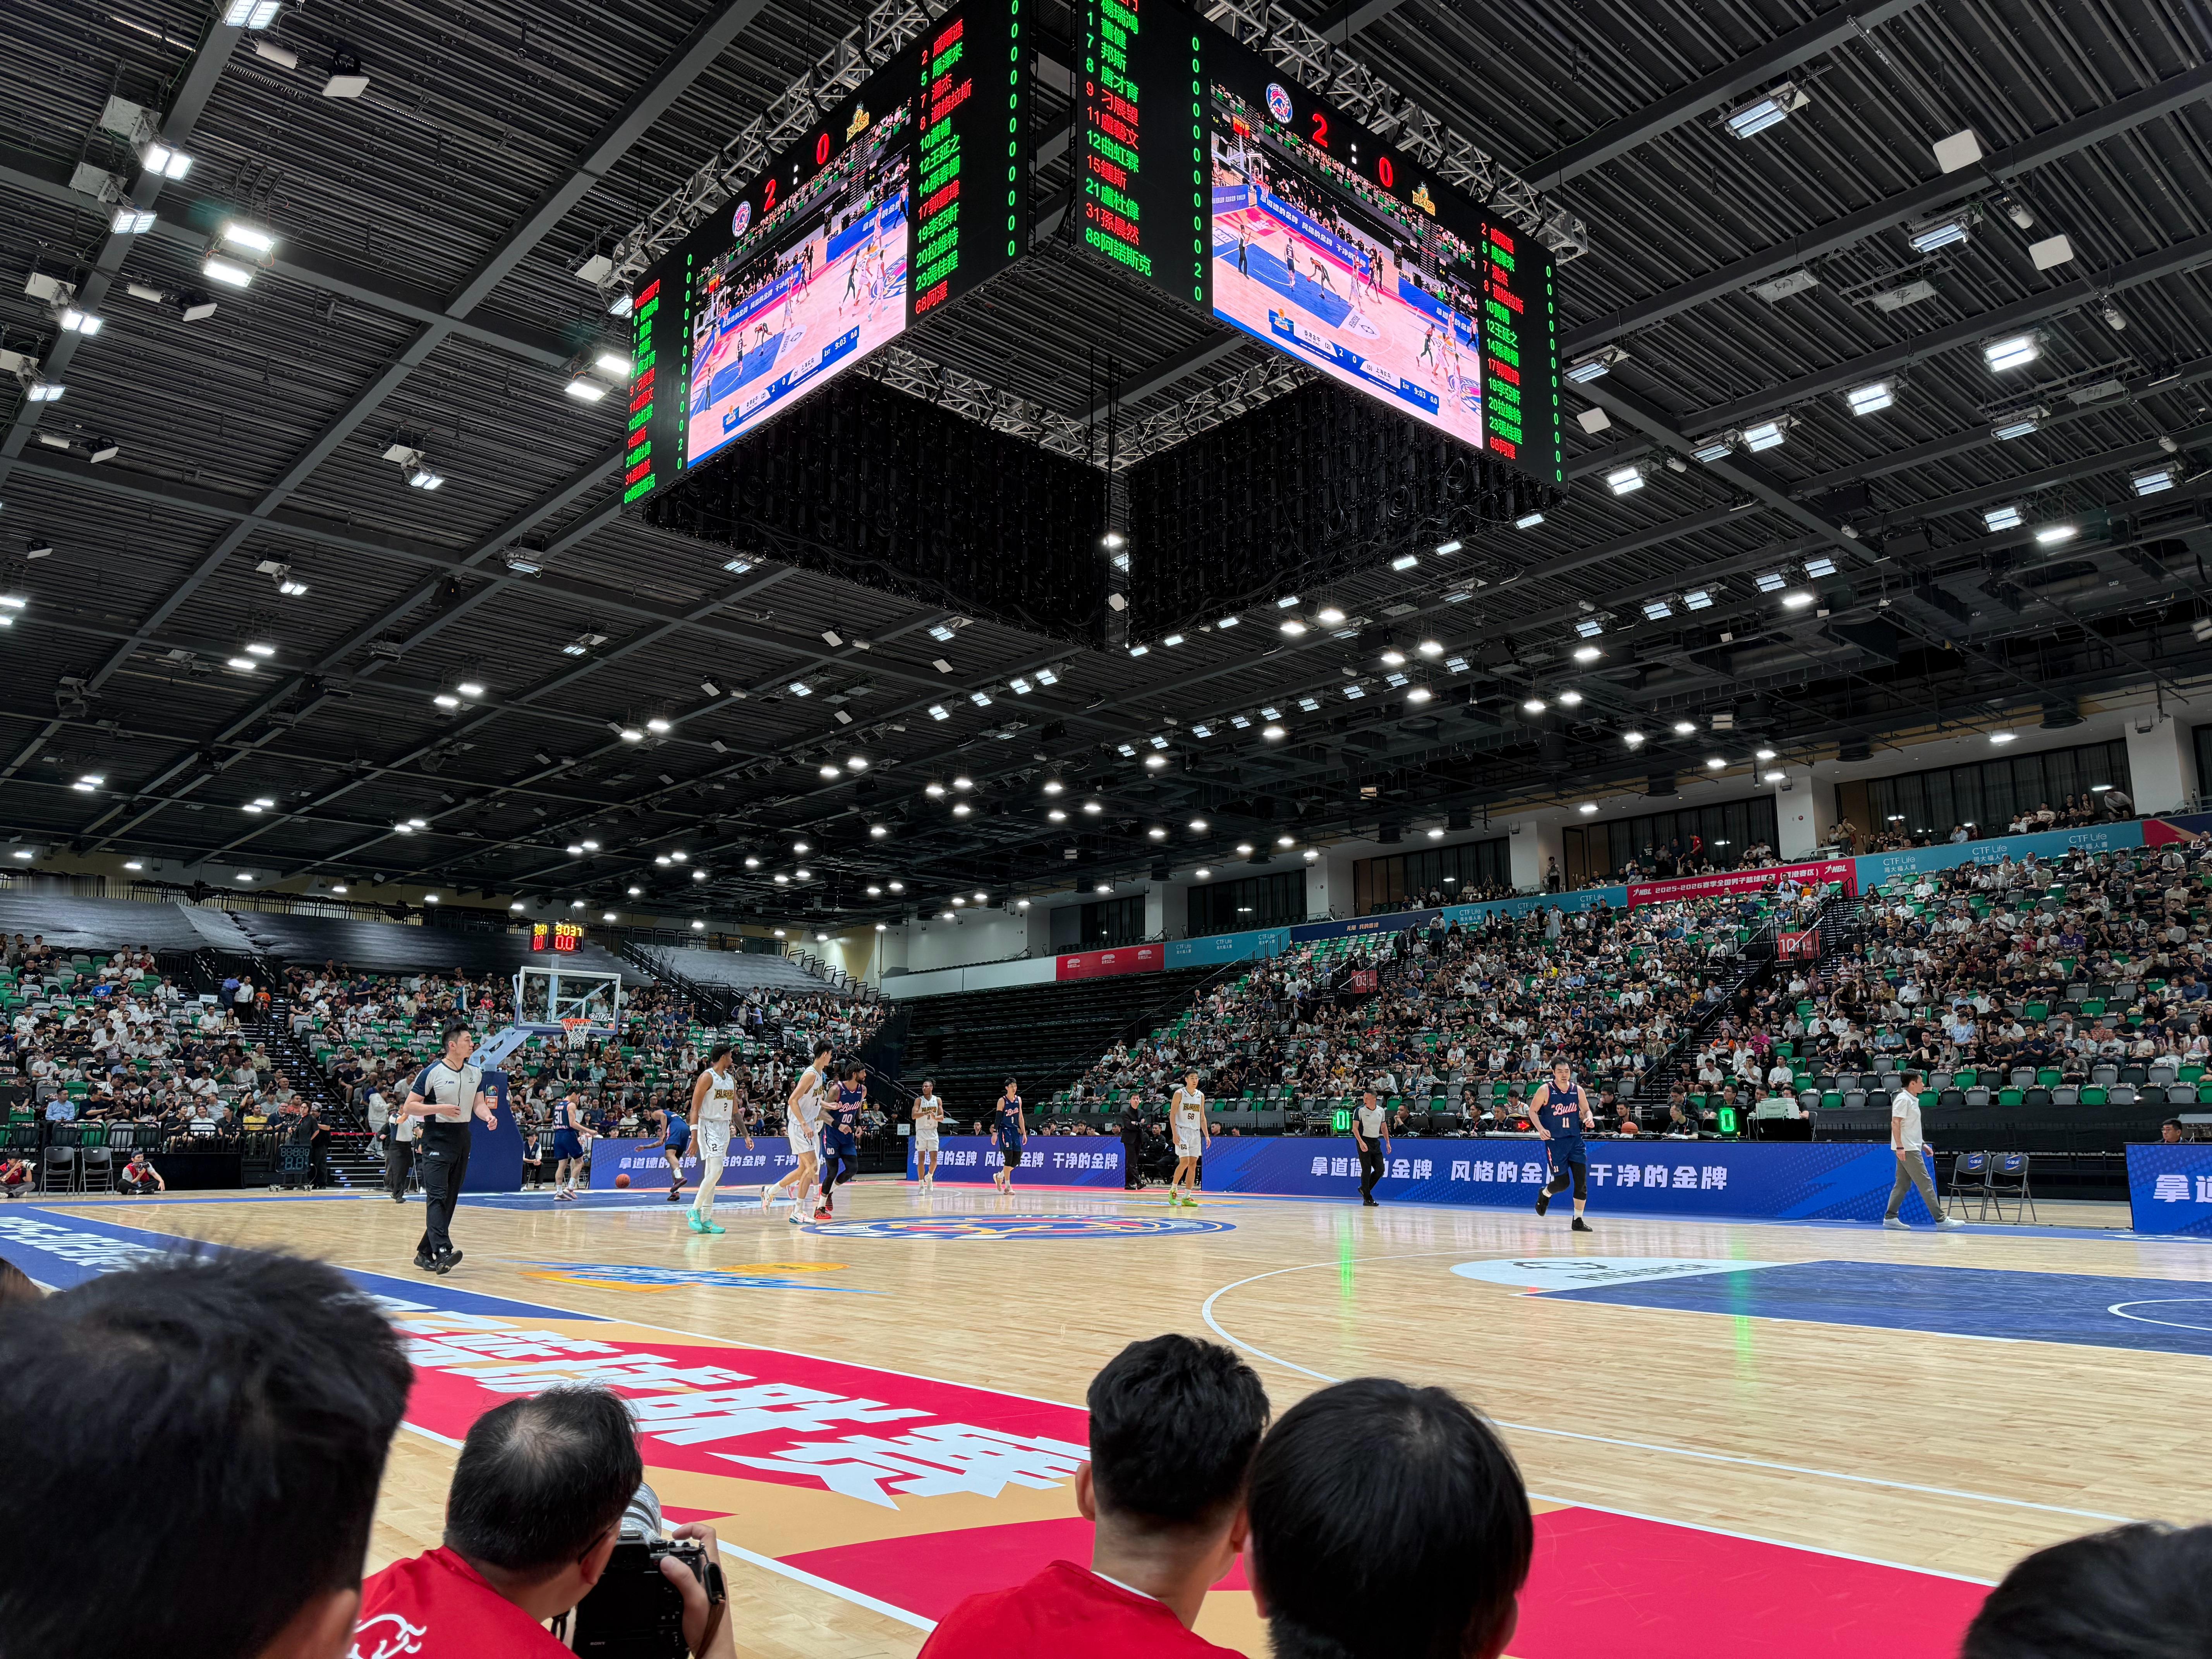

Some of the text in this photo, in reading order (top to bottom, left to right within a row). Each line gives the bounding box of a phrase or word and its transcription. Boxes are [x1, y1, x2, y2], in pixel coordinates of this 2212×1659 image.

[1012, 23, 1018, 38] 0
[921, 0, 1018, 86] 5 馬澤來 0
[1192, 37, 1199, 51] 0
[922, 50, 928, 65] 2
[1087, 12, 1199, 95] 1 董健 0
[1193, 59, 1199, 73] 0
[1010, 70, 1017, 85] 0
[1087, 33, 1200, 117] 7 邦斯 0
[920, 46, 1018, 130] 8 道格拉斯 0
[1010, 94, 1017, 109] 0
[1087, 58, 1200, 139] 8 唐才育 0
[1010, 118, 1016, 132] 0
[1086, 81, 1200, 162] 9 刁展望 0
[1009, 141, 1016, 157] 0
[1312, 113, 1393, 187] 2 0
[764, 133, 829, 212] 2 0
[1009, 166, 1015, 181] 0
[1194, 170, 1200, 184] 0
[1008, 191, 1015, 206] 0
[1194, 193, 1200, 207] 0
[1008, 215, 1015, 230] 0
[1194, 216, 1201, 230] 0
[1481, 223, 1486, 235] 2
[1008, 240, 1015, 256] 0
[1194, 239, 1201, 254] 0
[1482, 241, 1487, 254] 5
[1195, 263, 1201, 278] 2
[1483, 260, 1487, 271] 7
[1195, 286, 1201, 301] 0
[1484, 280, 1523, 314] 8 道格拉斯
[634, 315, 638, 326] 0
[633, 333, 636, 343] 1
[835, 337, 846, 350] 9:03
[630, 350, 656, 379] 8 唐才育
[630, 385, 634, 397] 9
[1414, 387, 1426, 399] 9:03
[2069, 833, 2107, 843] CTF Life
[1972, 845, 2007, 855] CTF Life
[1883, 857, 1900, 866] CTF
[724, 1103, 728, 1111] 2
[1553, 1103, 1578, 1116] Bulls
[554, 1111, 563, 1124] 31
[842, 1114, 853, 1123] 00
[1562, 1117, 1570, 1128] 11
[1720, 1109, 1735, 1132] 0
[985, 1151, 1044, 1168] 风格金牌
[1053, 1152, 1118, 1170] 干净的金牌
[1589, 1164, 1727, 1190] 干净的金牌
